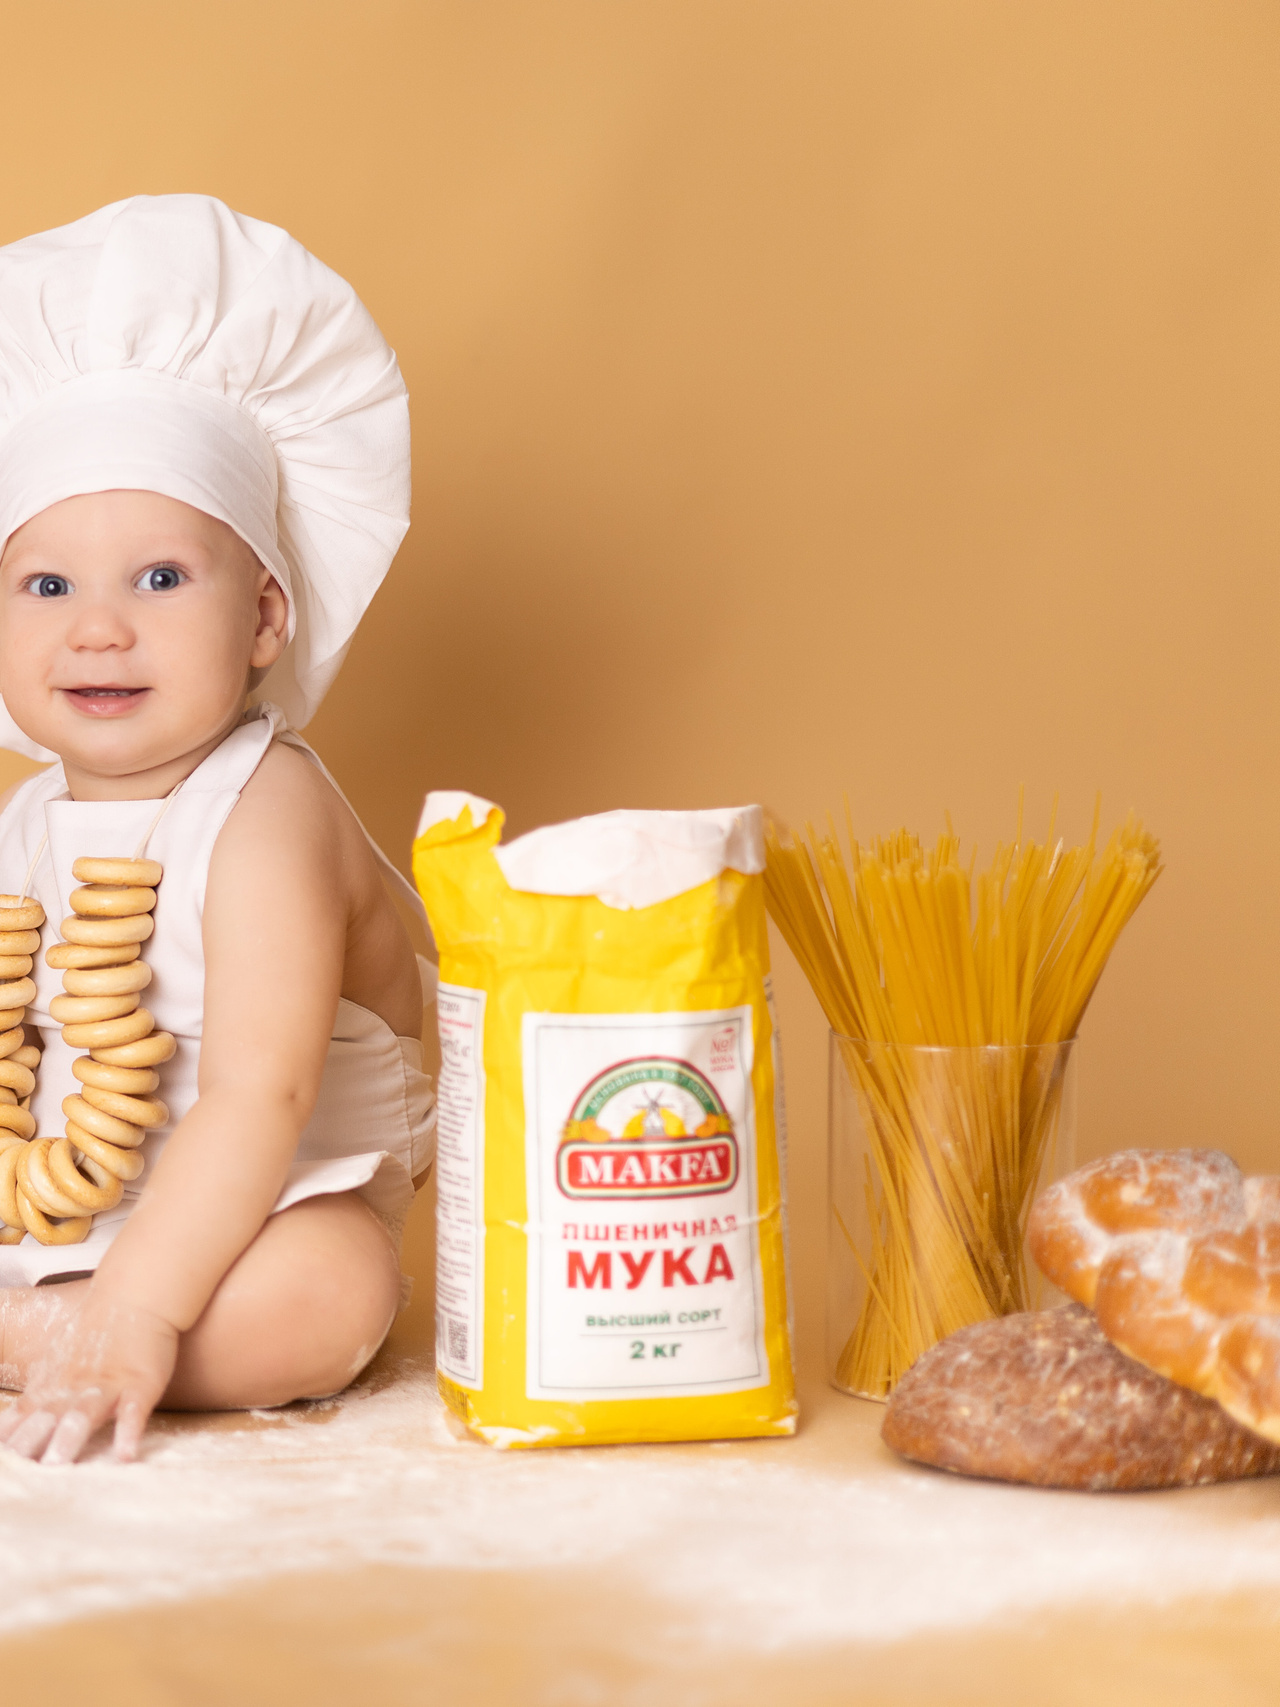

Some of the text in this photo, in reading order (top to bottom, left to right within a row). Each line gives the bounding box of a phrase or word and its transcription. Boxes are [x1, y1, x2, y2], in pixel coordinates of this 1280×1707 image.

[578, 1151, 721, 1184] MAKFA
[562, 1215, 738, 1241] ПШЕНИЧНАЯ
[567, 1243, 735, 1290] МУКА
[586, 1308, 722, 1327] ВЫСШИЙ СОРТ
[630, 1341, 646, 1359] 2
